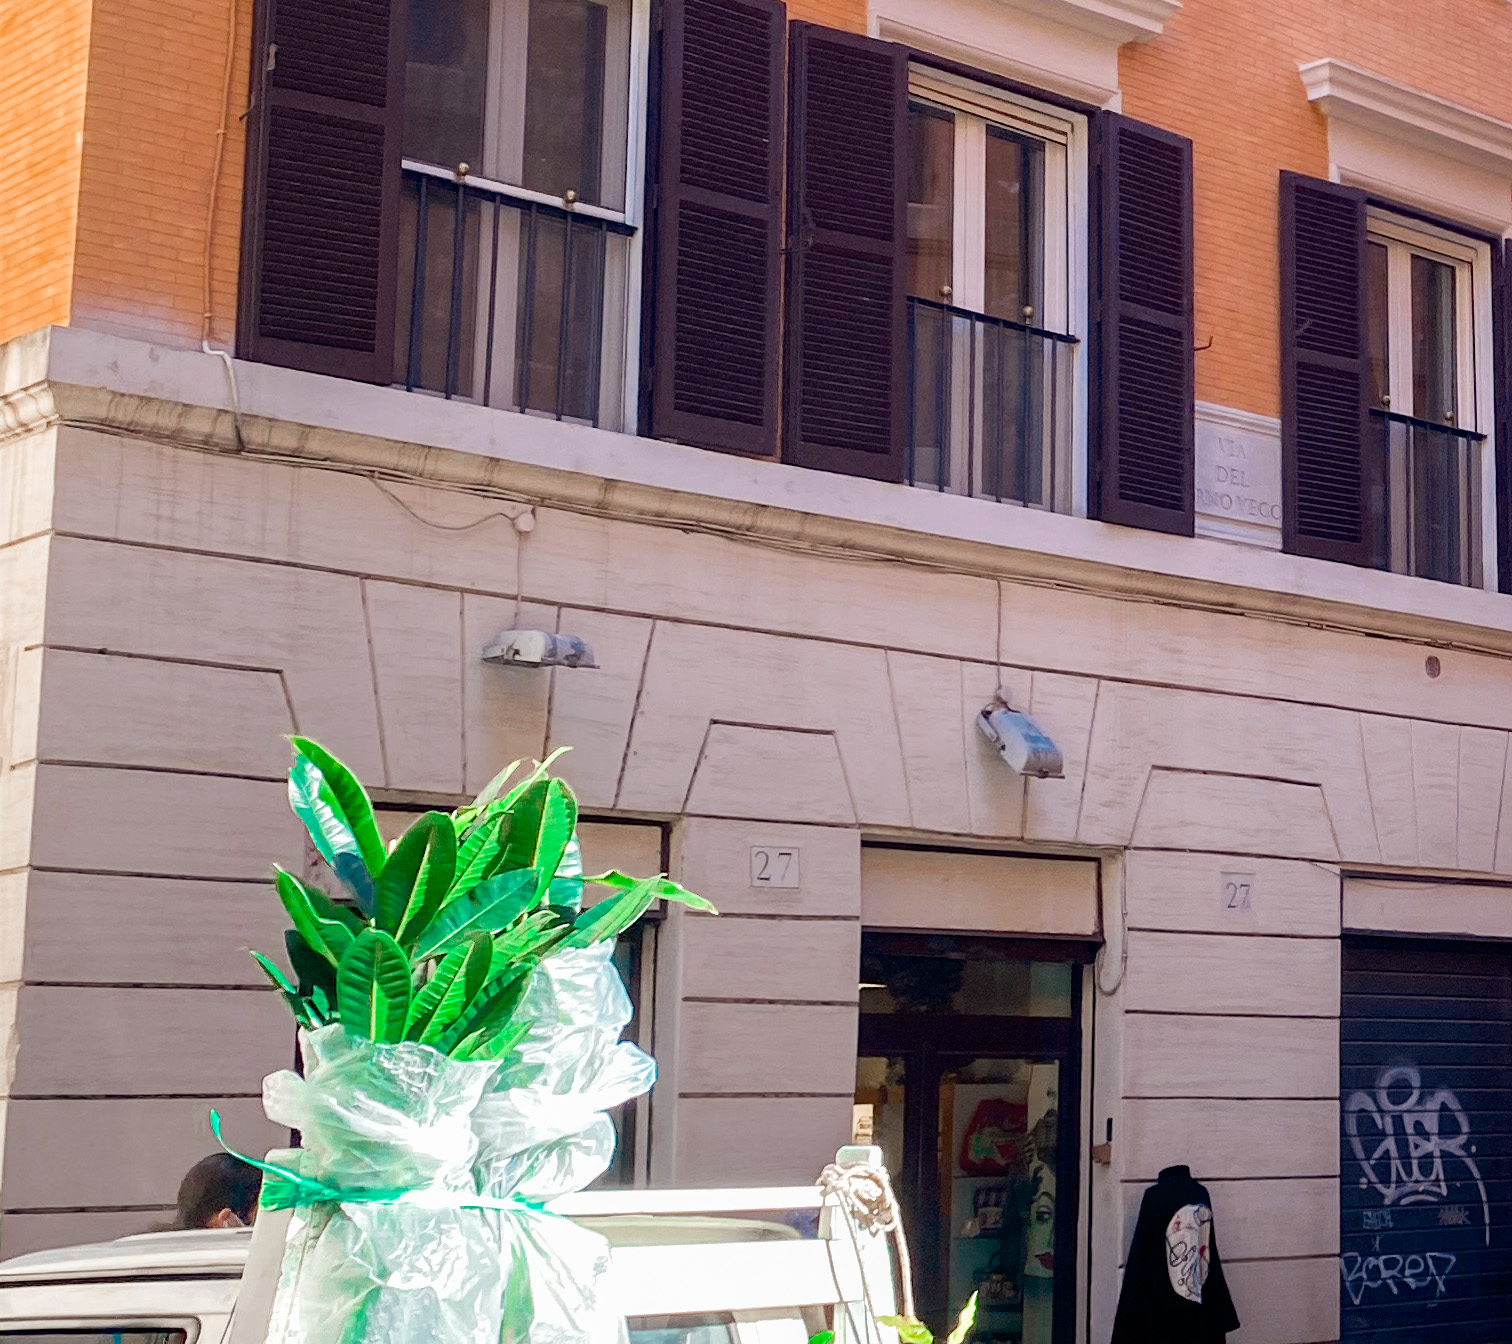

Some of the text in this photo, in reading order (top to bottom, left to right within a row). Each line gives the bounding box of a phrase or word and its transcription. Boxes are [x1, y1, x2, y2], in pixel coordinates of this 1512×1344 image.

[1217, 437, 1247, 459] VIA
[1216, 465, 1250, 487] DEL
[754, 850, 793, 881] 27
[1225, 882, 1251, 909] 27
